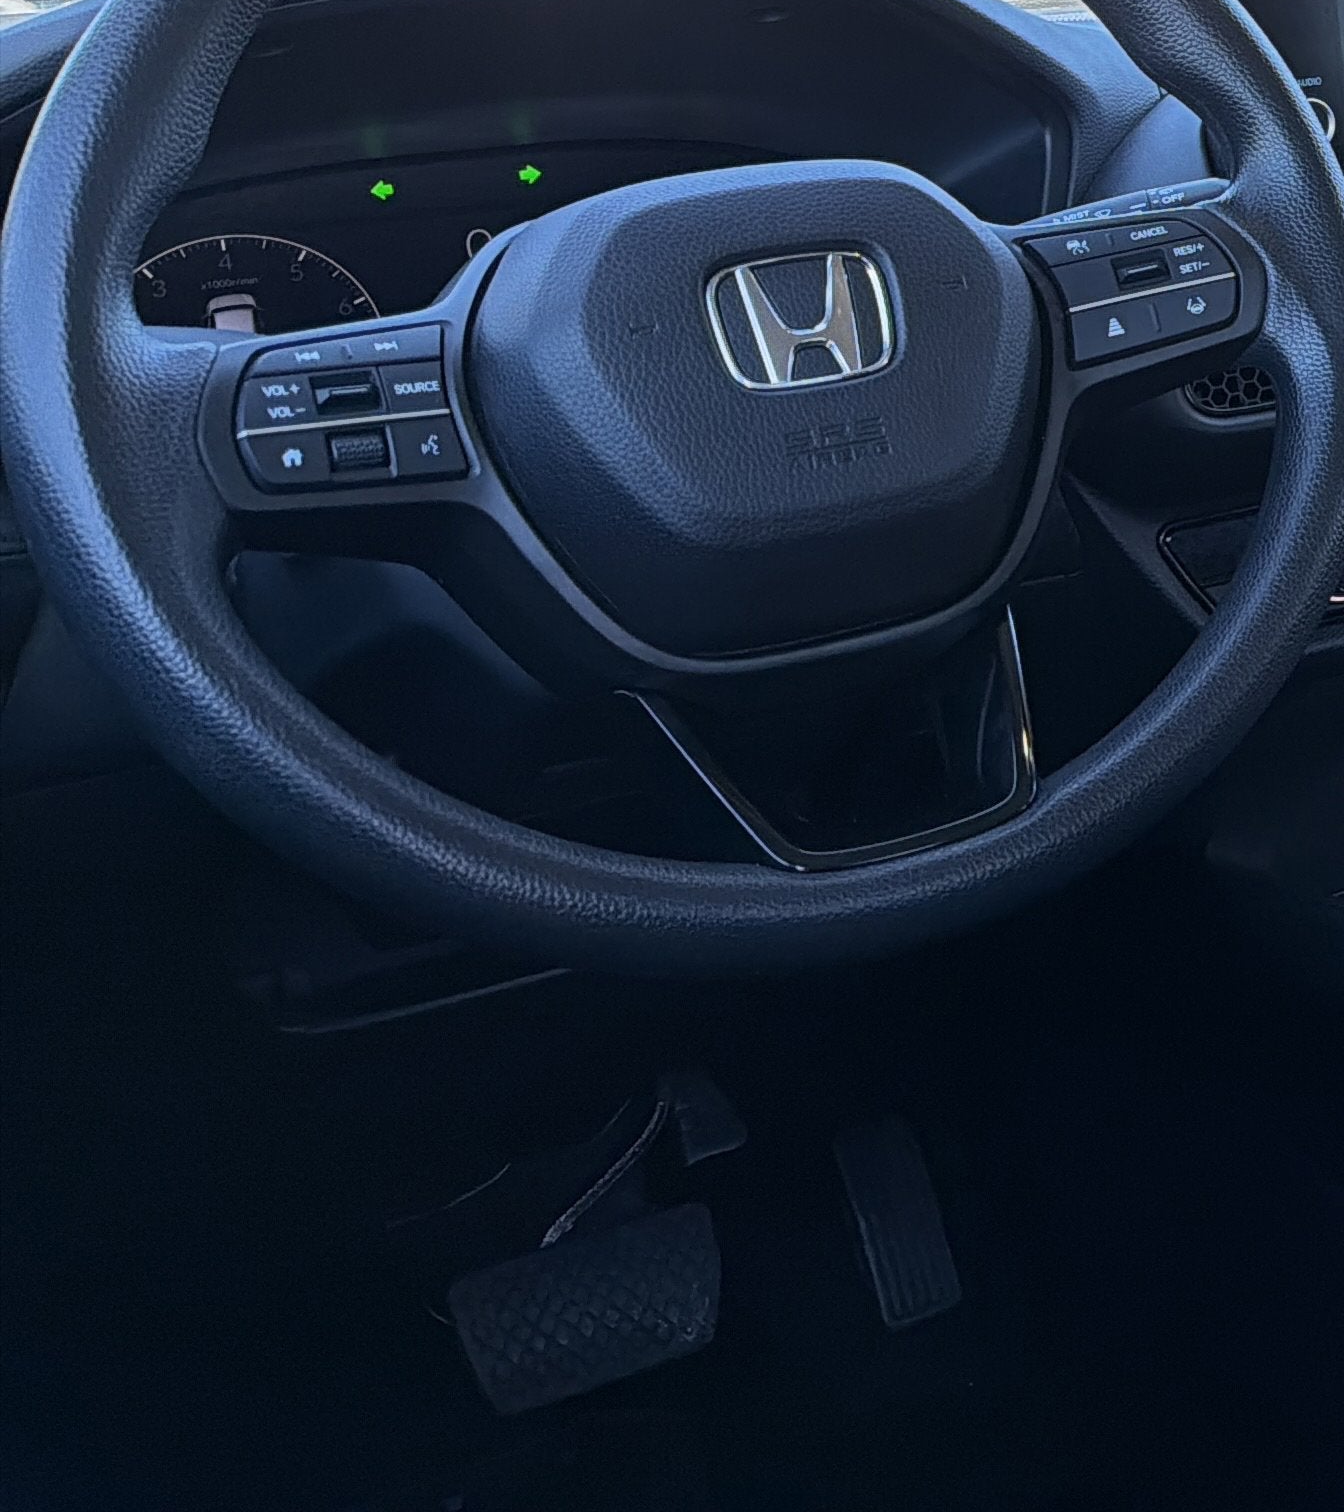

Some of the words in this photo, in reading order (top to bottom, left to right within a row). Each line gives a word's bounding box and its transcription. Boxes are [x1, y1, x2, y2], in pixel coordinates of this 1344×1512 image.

[1161, 191, 1185, 205] OFF
[1130, 225, 1169, 241] CANCEL
[218, 253, 233, 270] 4
[290, 263, 304, 282] 5
[151, 279, 167, 299] 3
[338, 297, 353, 316] 6
[394, 380, 441, 395] SOURCE
